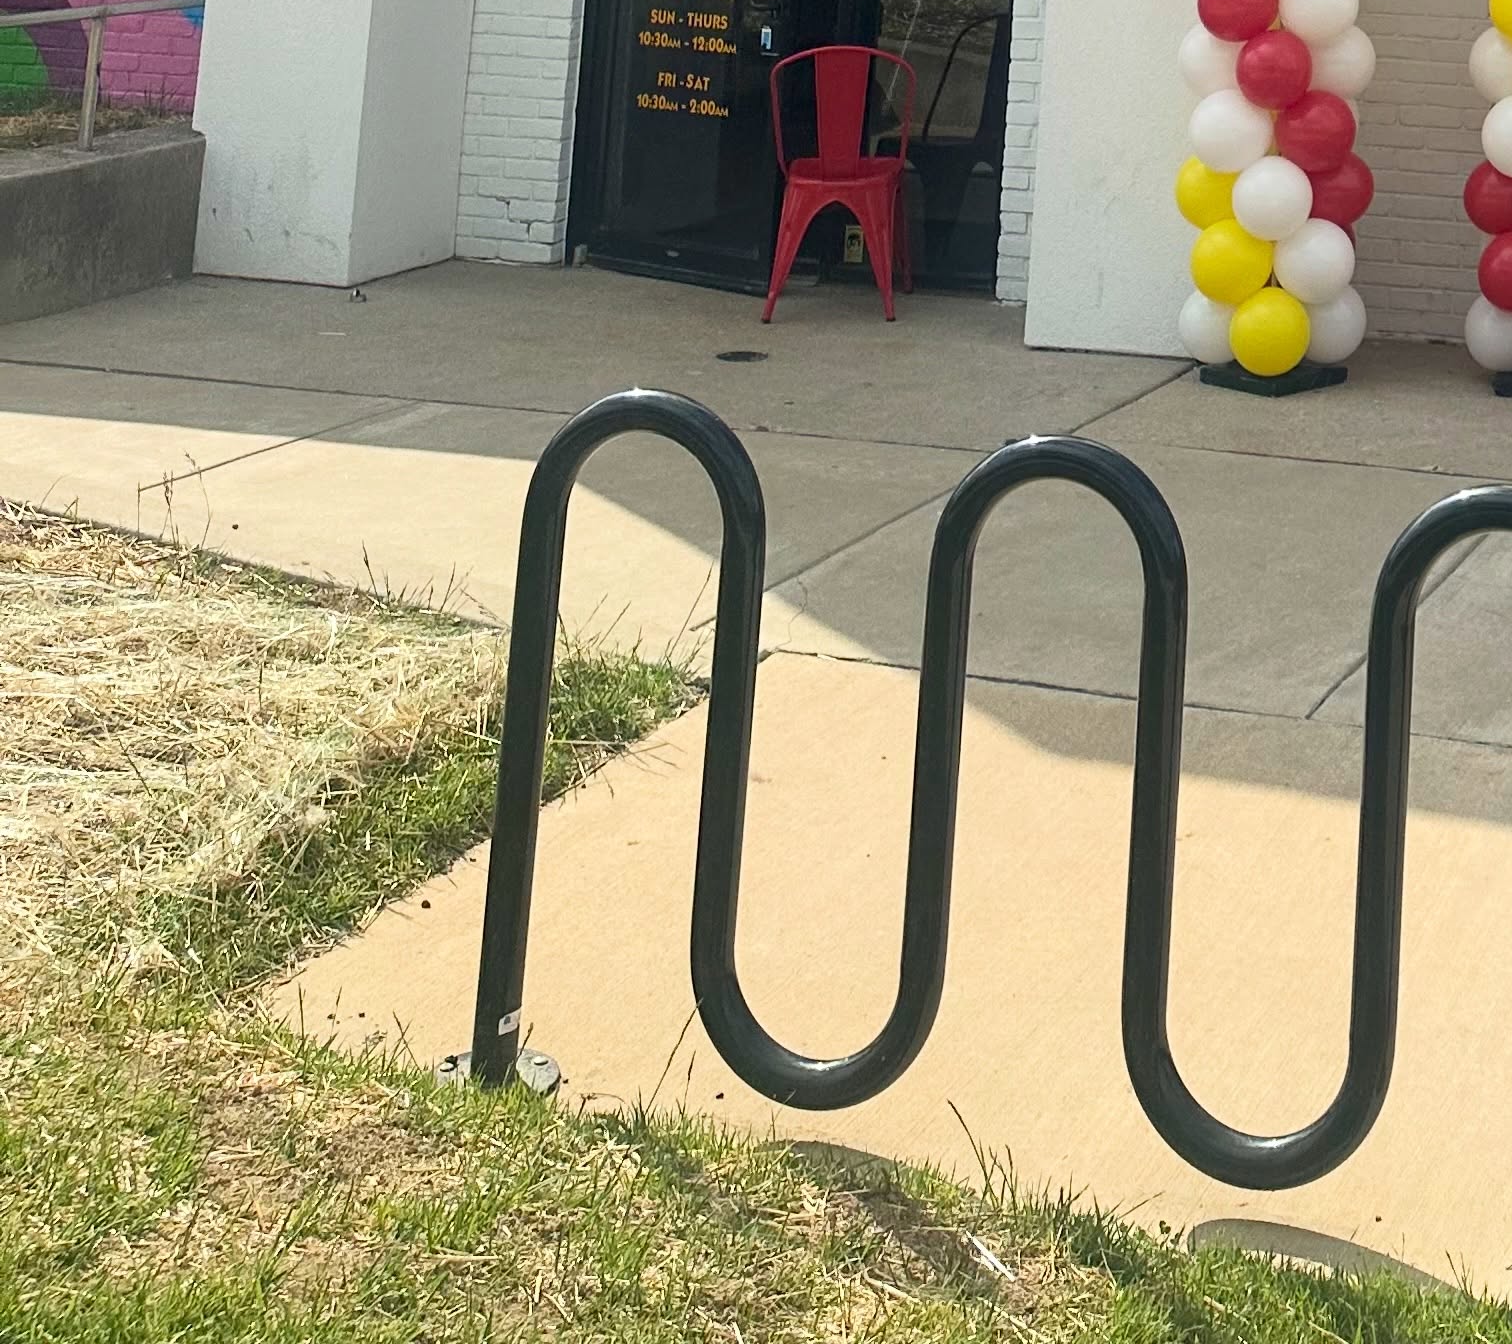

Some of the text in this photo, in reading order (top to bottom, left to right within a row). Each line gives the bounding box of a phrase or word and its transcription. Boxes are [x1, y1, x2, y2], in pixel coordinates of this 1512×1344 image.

[651, 9, 675, 25] SUN
[687, 12, 728, 30] THURS
[638, 31, 681, 49] 10:30AM
[692, 36, 736, 54] 12:00AM
[657, 72, 676, 88] FRI
[686, 74, 710, 91] SAT
[637, 94, 678, 111] 10:30AM
[690, 99, 728, 117] 2:00AM
